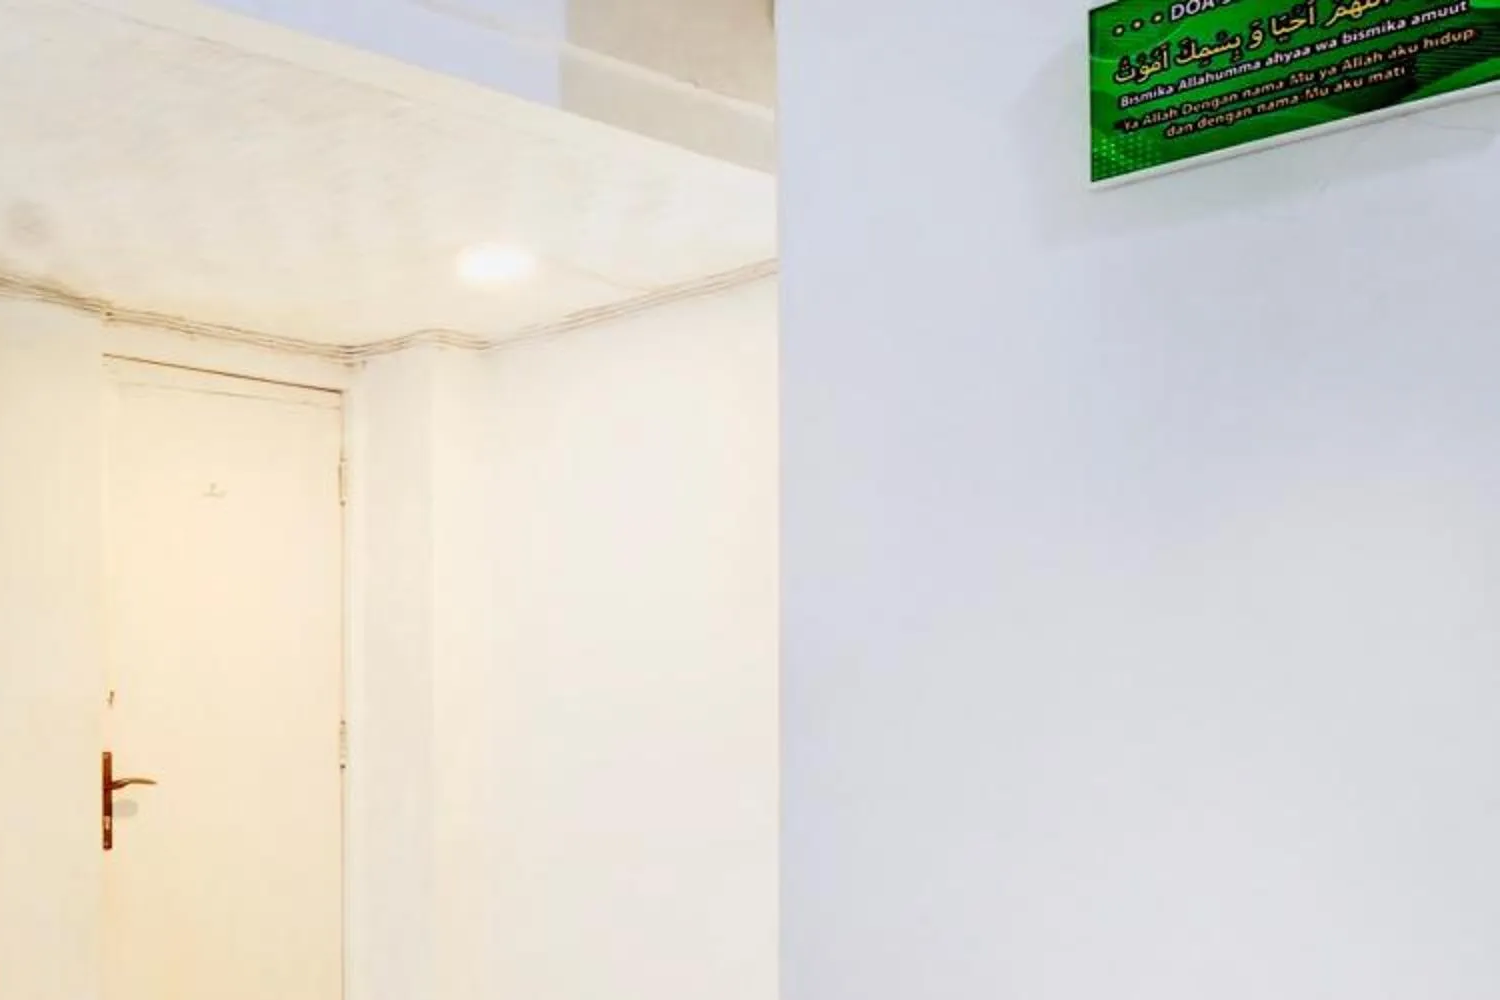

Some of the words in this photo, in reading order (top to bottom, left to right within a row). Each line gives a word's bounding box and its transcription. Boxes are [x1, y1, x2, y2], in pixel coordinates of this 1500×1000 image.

[1120, 86, 1175, 107] Bismika
[1178, 60, 1261, 91] Allahumma
[1265, 46, 1311, 67] ahyaa
[1315, 38, 1337, 52] wa
[1342, 19, 1406, 44] bismika
[1411, 1, 1467, 25] amuut
[1143, 108, 1178, 125] Allah
[1181, 92, 1238, 115] Dengan
[1319, 65, 1337, 81] ya
[1342, 52, 1383, 71] Allah
[1388, 44, 1419, 60] aku
[1423, 28, 1475, 49] hidup
[1167, 122, 1193, 137] dan
[1197, 107, 1252, 128] dengan
[1334, 77, 1364, 93] aku
[1368, 66, 1406, 84] mati
